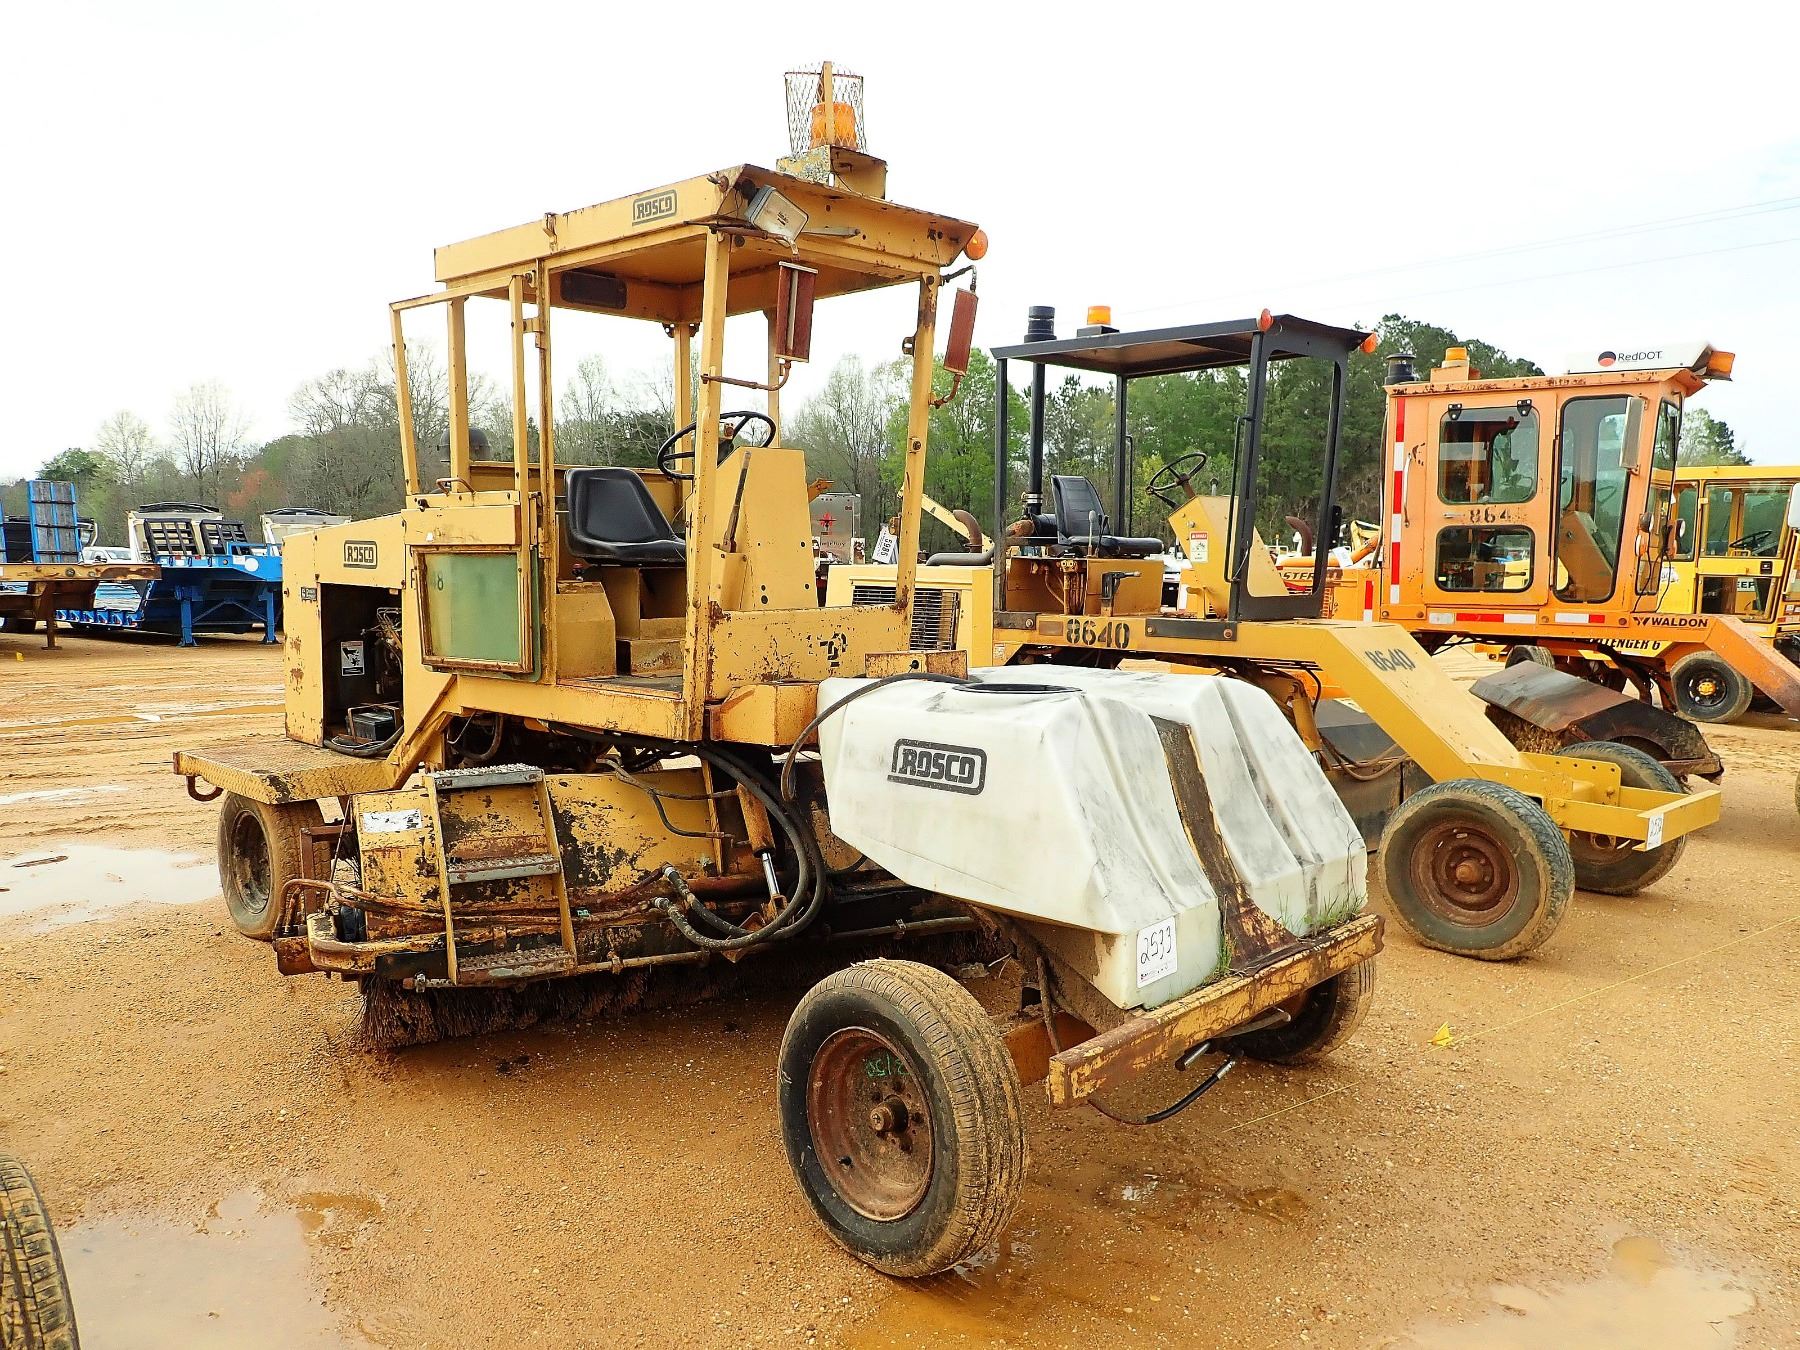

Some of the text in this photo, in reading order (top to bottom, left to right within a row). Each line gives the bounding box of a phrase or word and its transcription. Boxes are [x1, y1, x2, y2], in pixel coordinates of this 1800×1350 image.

[636, 195, 673, 219] ROSCO
[1617, 350, 1663, 361] RedDOT
[1469, 507, 1518, 523] 864
[347, 546, 374, 563] ROSCO
[1066, 618, 1130, 649] 8640
[1651, 617, 1709, 628] WALDON
[1364, 649, 1416, 671] 8640
[898, 748, 976, 785] ROSCO
[1140, 925, 1172, 965] 2533
